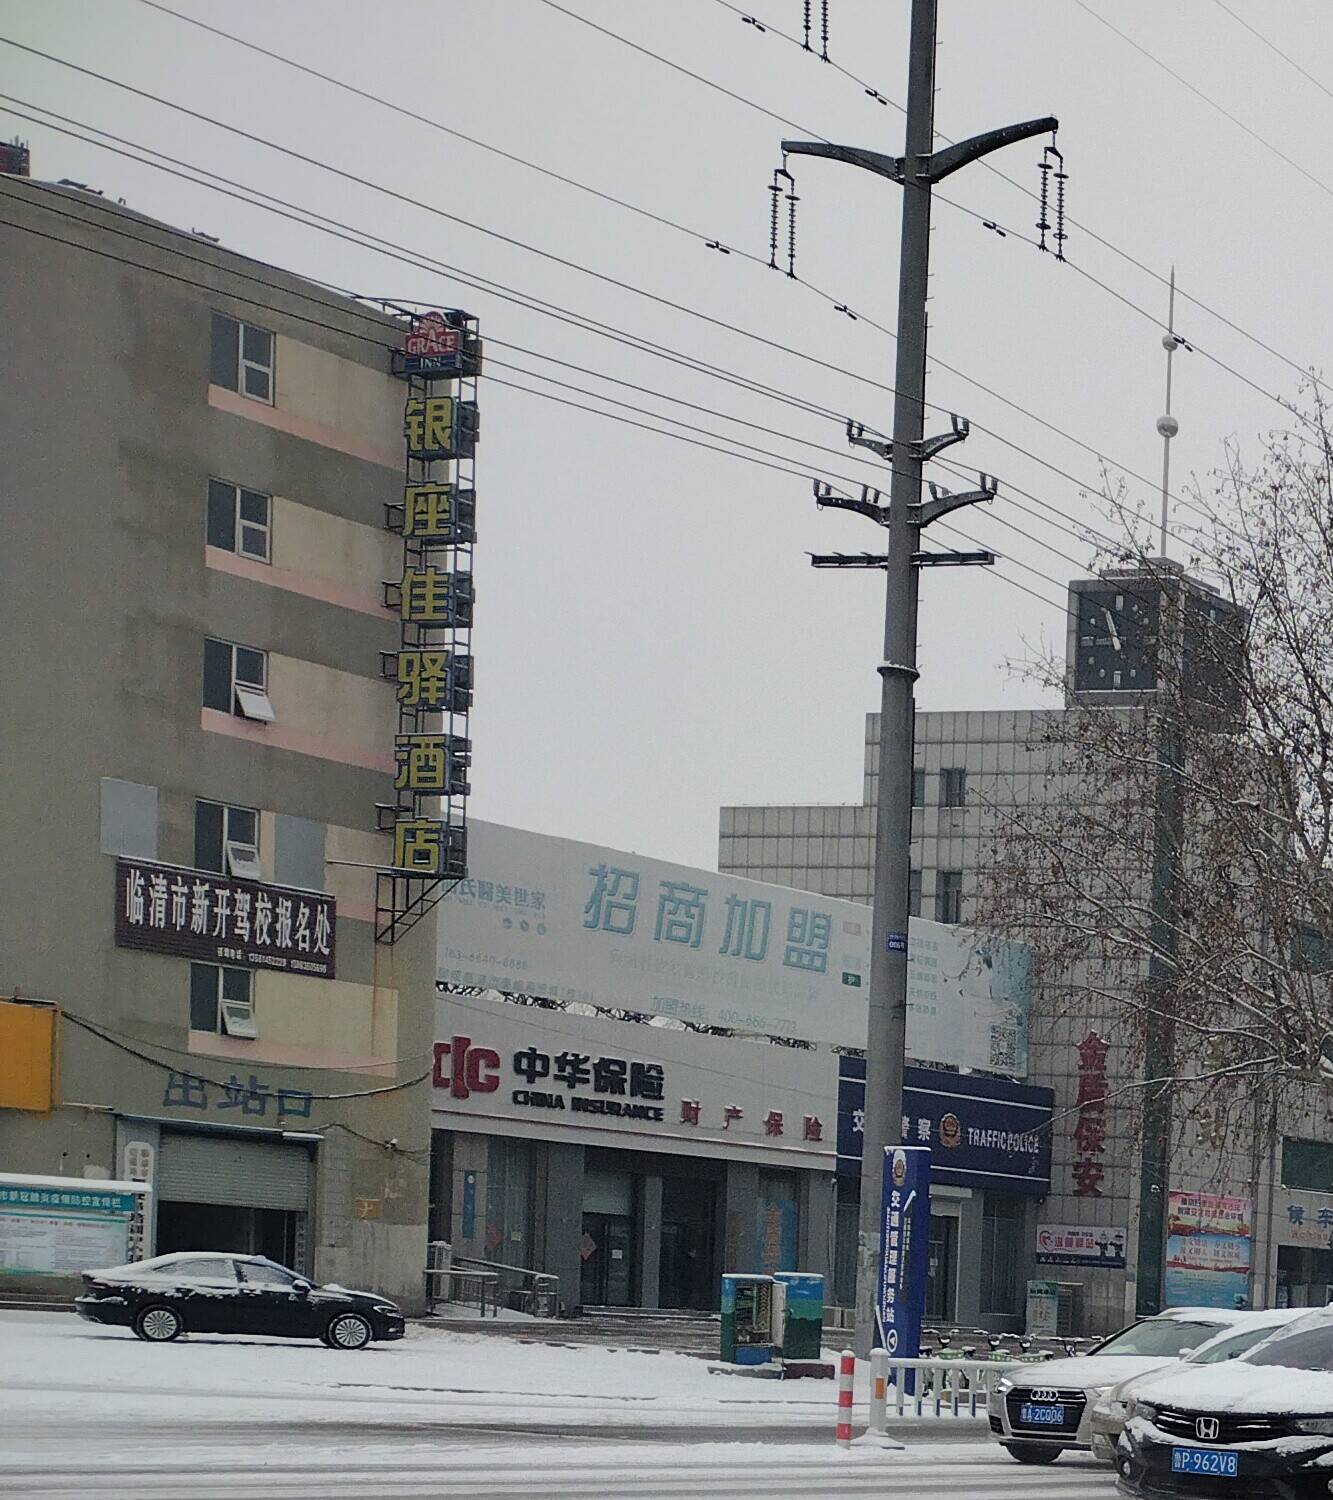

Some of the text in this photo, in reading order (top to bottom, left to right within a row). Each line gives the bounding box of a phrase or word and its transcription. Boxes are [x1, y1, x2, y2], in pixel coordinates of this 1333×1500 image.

[407, 329, 455, 354] GRACE
[393, 397, 453, 874] 银座佳驿酒店
[126, 869, 330, 955] 临清市新开驾校报名处
[583, 864, 832, 972] 招商加盟
[163, 1072, 312, 1118] 出站口
[513, 1047, 665, 1100] 中华保险
[512, 1090, 664, 1121] CHINA INSURANCE
[680, 1098, 823, 1141] 财产保险
